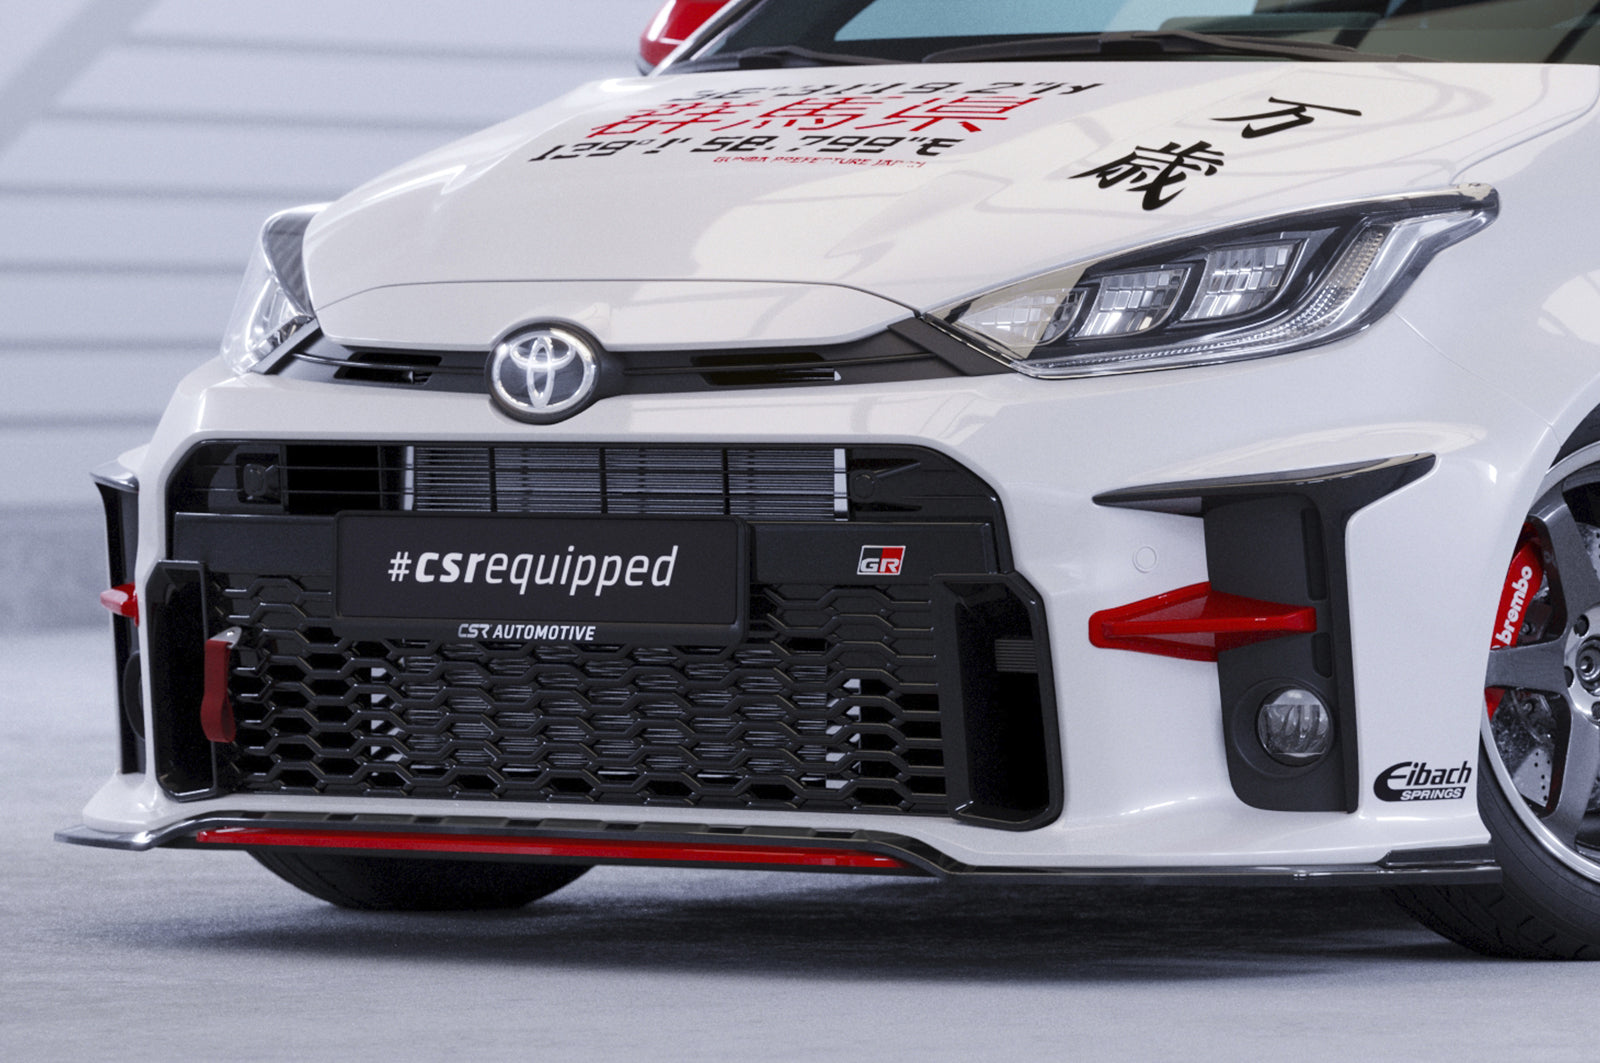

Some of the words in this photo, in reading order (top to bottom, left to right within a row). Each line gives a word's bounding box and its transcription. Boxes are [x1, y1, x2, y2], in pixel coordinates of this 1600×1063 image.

[388, 545, 679, 596] #csrequipped
[859, 557, 901, 573] GR
[1495, 565, 1533, 645] brembo
[457, 623, 492, 639] CSR
[492, 624, 596, 641] AUTOMOTIVE
[1373, 760, 1472, 802] Eibach
[1400, 788, 1463, 801] SPRINGS
